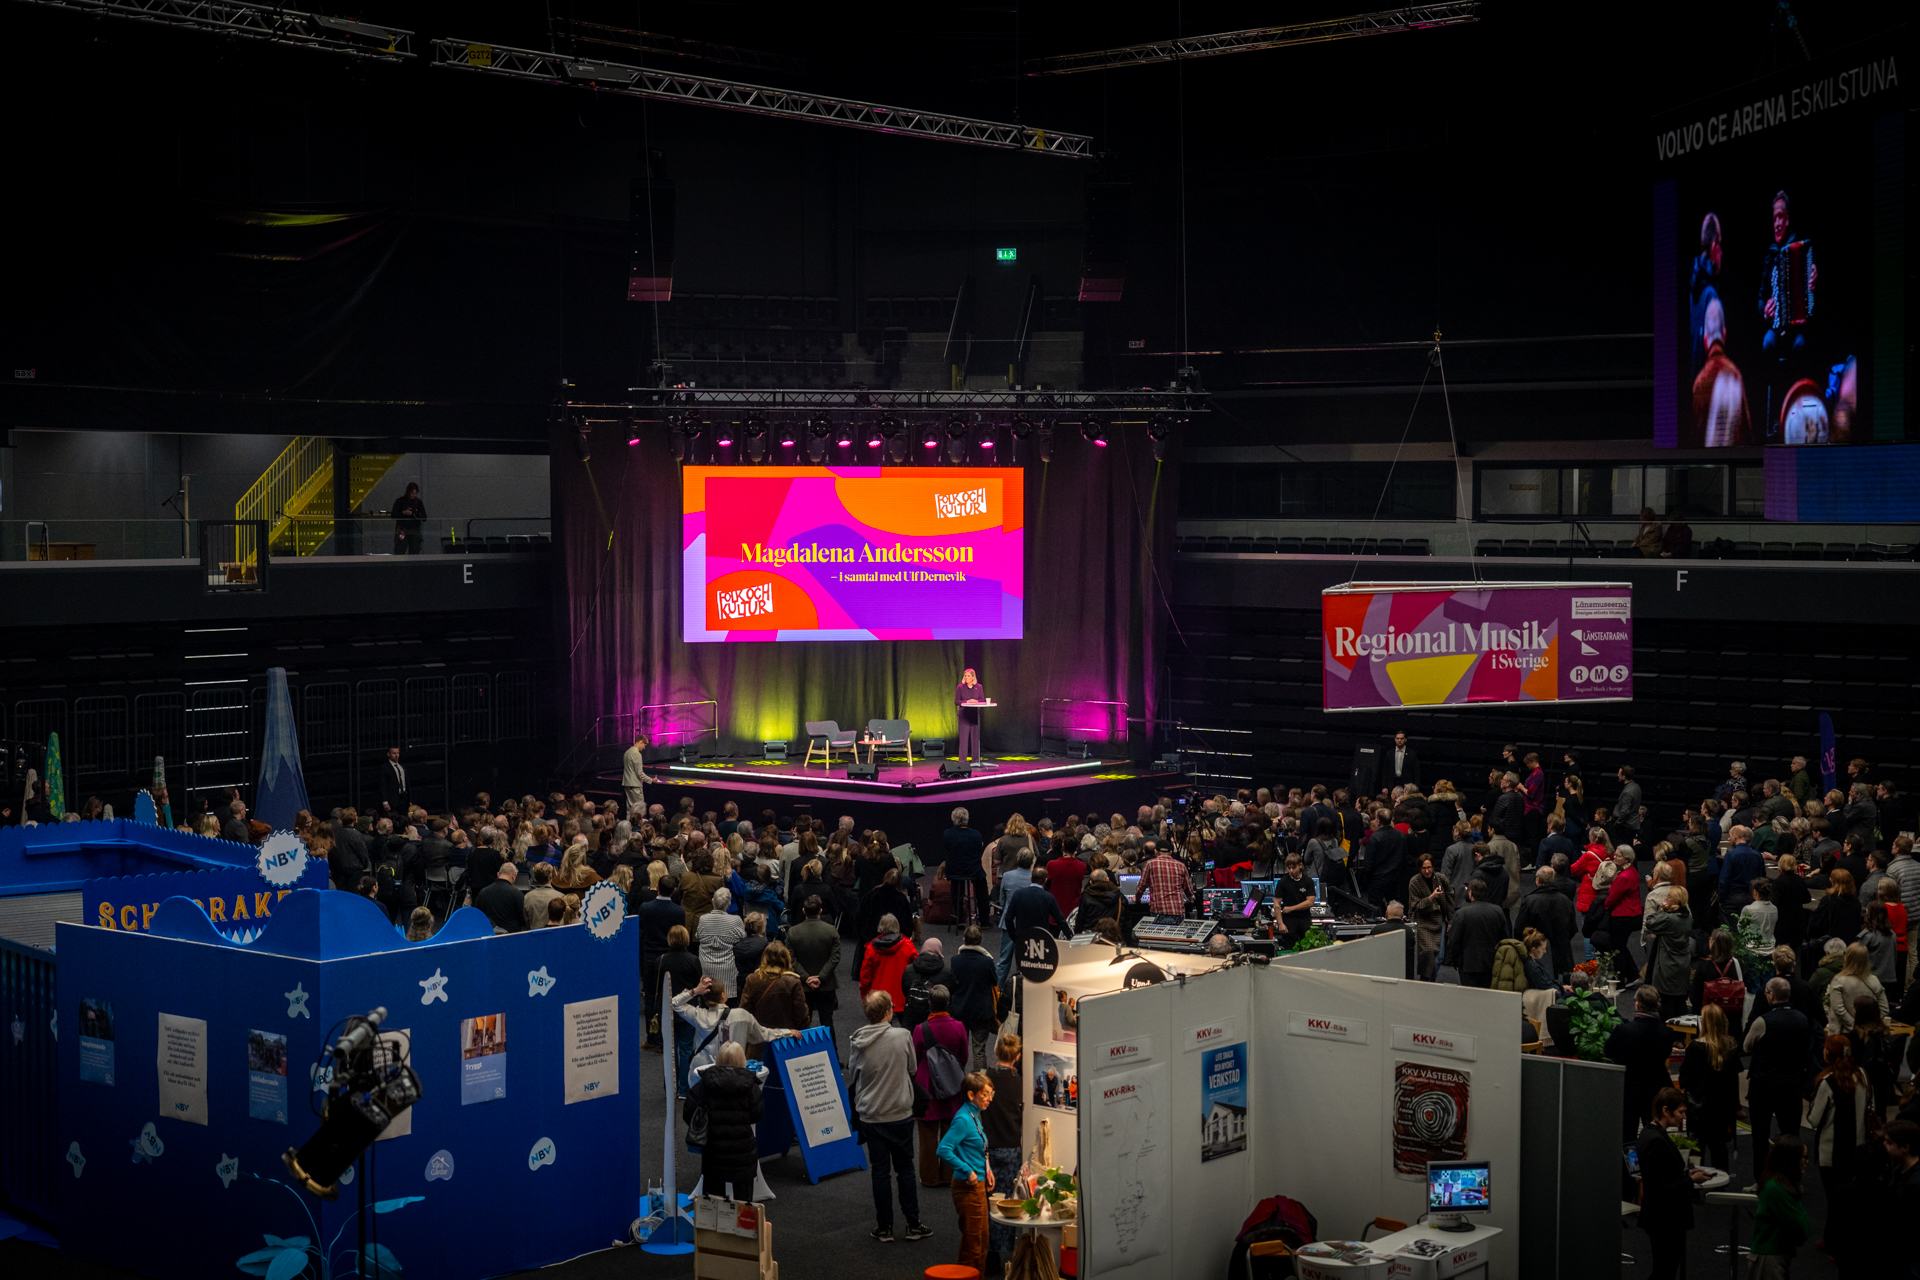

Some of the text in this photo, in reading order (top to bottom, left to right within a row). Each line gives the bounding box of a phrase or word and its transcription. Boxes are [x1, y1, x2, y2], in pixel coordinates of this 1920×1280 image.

[1657, 56, 1898, 161] VOLVO CE ARENA ESKILSTUNA
[740, 542, 974, 567] Magdalena Andersson
[464, 563, 474, 584] E
[844, 571, 878, 582] samtal
[880, 571, 901, 582] med
[903, 571, 920, 582] Ulf
[920, 571, 967, 582] Dernevik
[1677, 570, 1689, 592] F
[1575, 600, 1628, 608] Länsmuseerna
[1334, 619, 1549, 662] Regional Musik
[1583, 630, 1628, 641] LÄNSTEATRARNA
[1491, 653, 1549, 671] i Sverige
[264, 848, 298, 871] NBV
[591, 897, 616, 928] NBV
[427, 981, 442, 993] NBV
[531, 975, 551, 987] NBV
[1209, 1068, 1240, 1089] VERKSTAD
[1401, 1067, 1419, 1076] KKV
[1420, 1069, 1464, 1083] VÄSTERÅS
[531, 1145, 552, 1165] NBV
